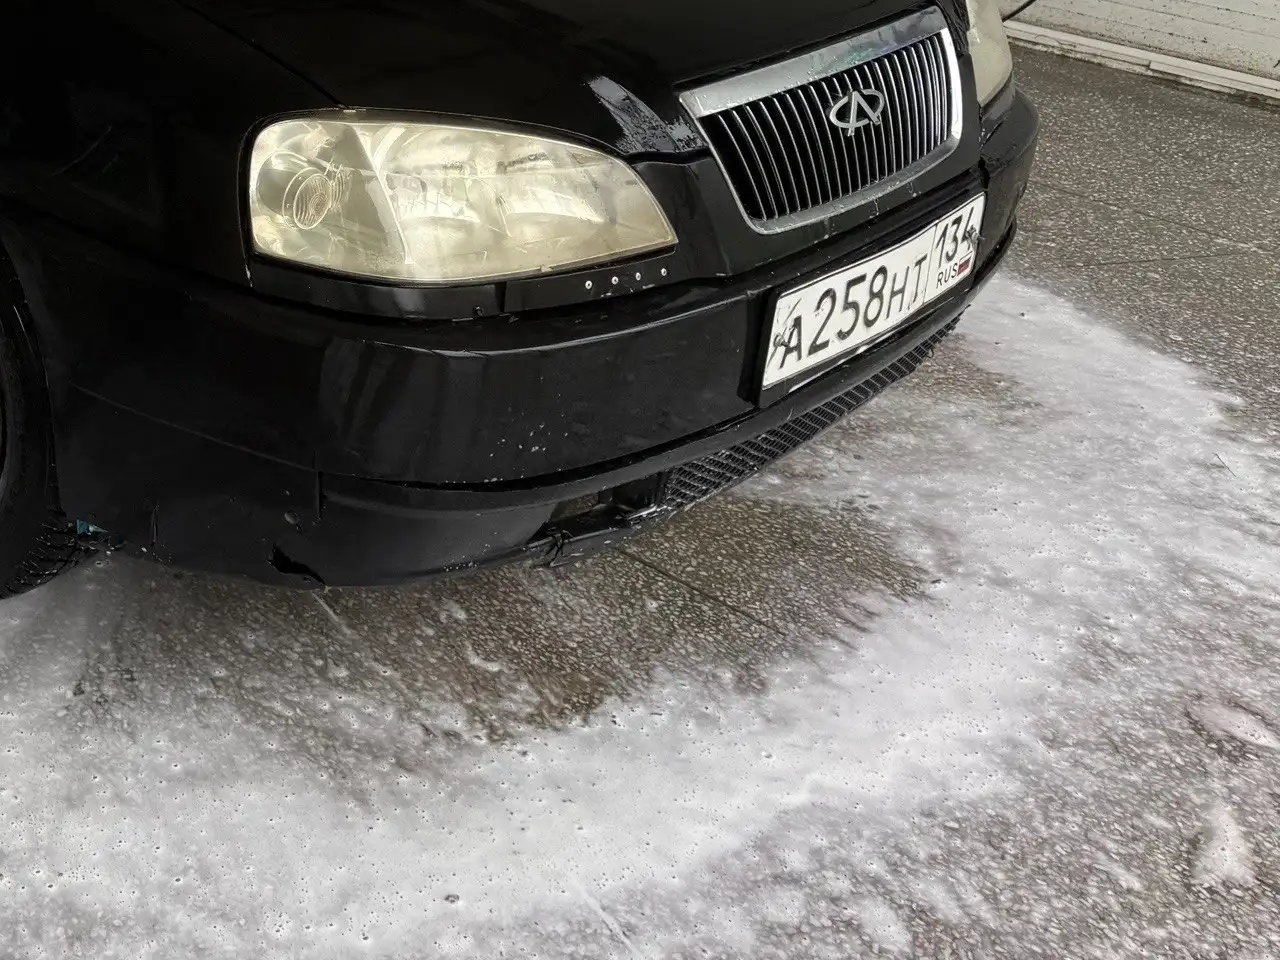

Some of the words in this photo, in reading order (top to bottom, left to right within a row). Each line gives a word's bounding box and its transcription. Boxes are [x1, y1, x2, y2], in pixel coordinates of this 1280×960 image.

[935, 206, 975, 269] 134
[935, 262, 958, 287] RUS
[780, 253, 928, 369] А258НТ
